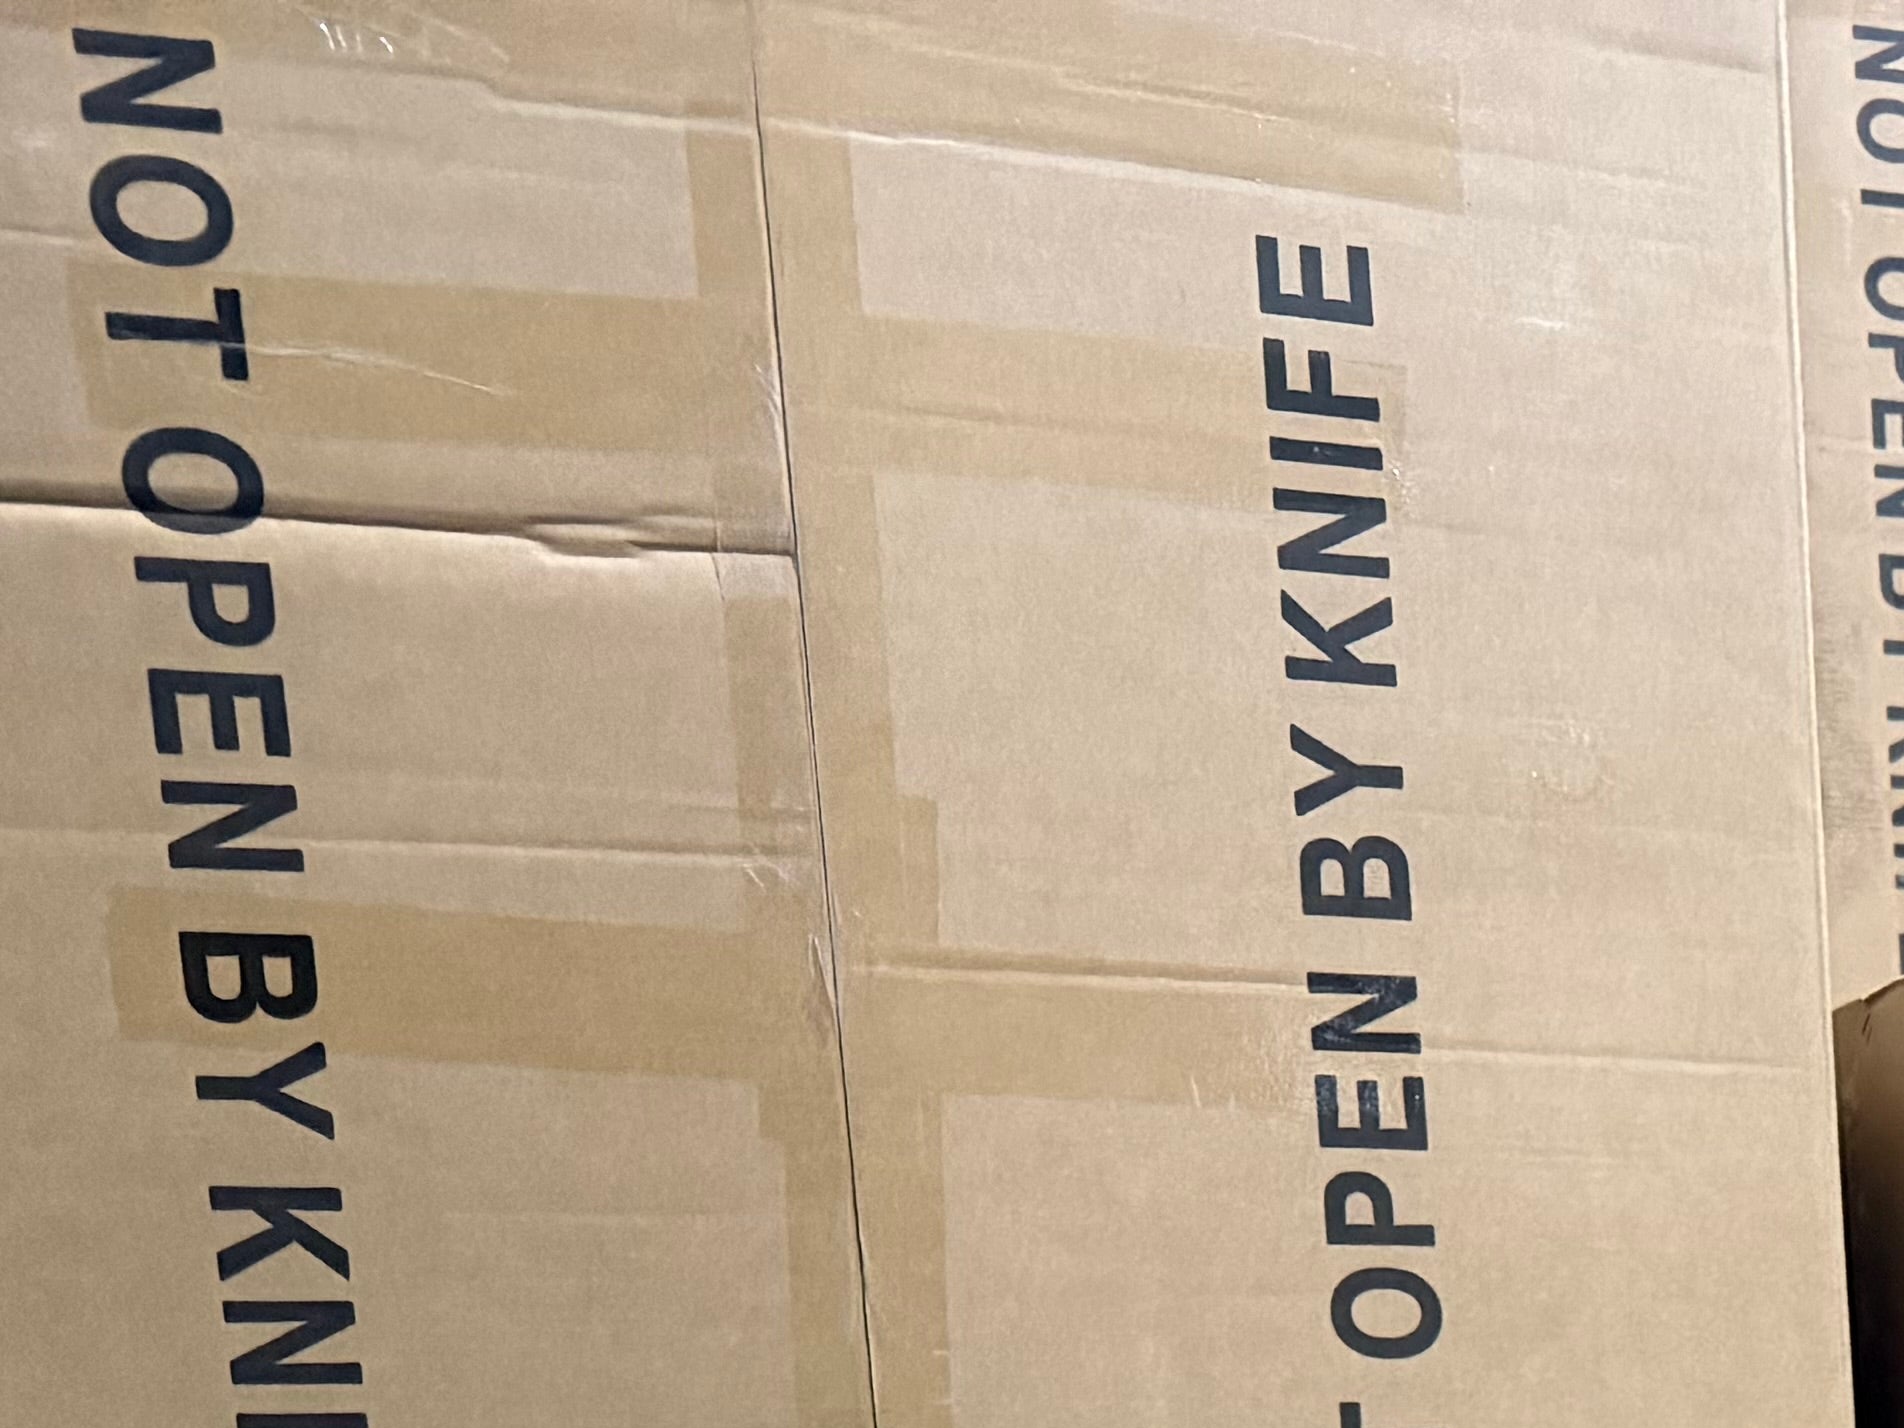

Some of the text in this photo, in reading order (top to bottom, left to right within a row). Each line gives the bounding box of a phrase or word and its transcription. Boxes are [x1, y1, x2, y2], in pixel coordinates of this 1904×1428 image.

[72, 28, 248, 381] NOT
[1255, 235, 1397, 687] KNIFE
[121, 427, 304, 872] OPEN
[1290, 723, 1412, 920] BY
[179, 931, 334, 1139] BY
[1307, 973, 1442, 1359] OPEN
